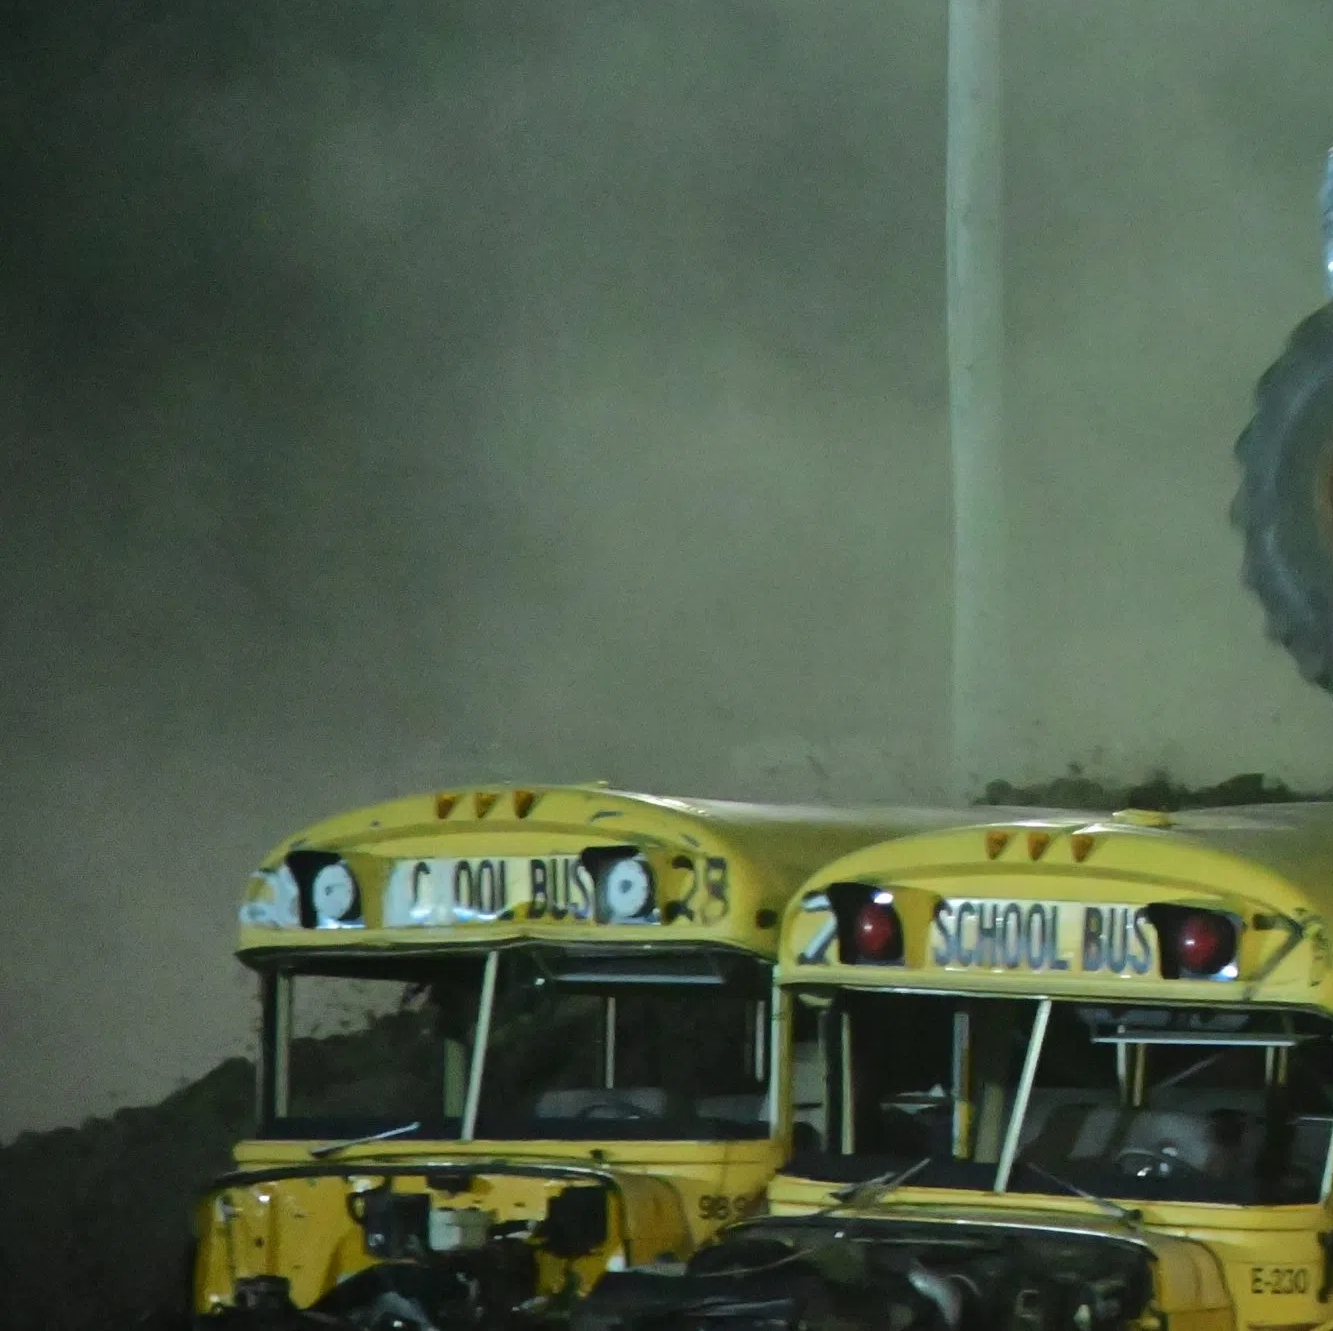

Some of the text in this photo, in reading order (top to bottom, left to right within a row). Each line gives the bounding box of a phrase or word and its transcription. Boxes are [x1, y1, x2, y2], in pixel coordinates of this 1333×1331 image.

[529, 858, 592, 920] BUS
[932, 898, 1155, 974] SCHOOL BUS
[1251, 1267, 1308, 1294] E-230
